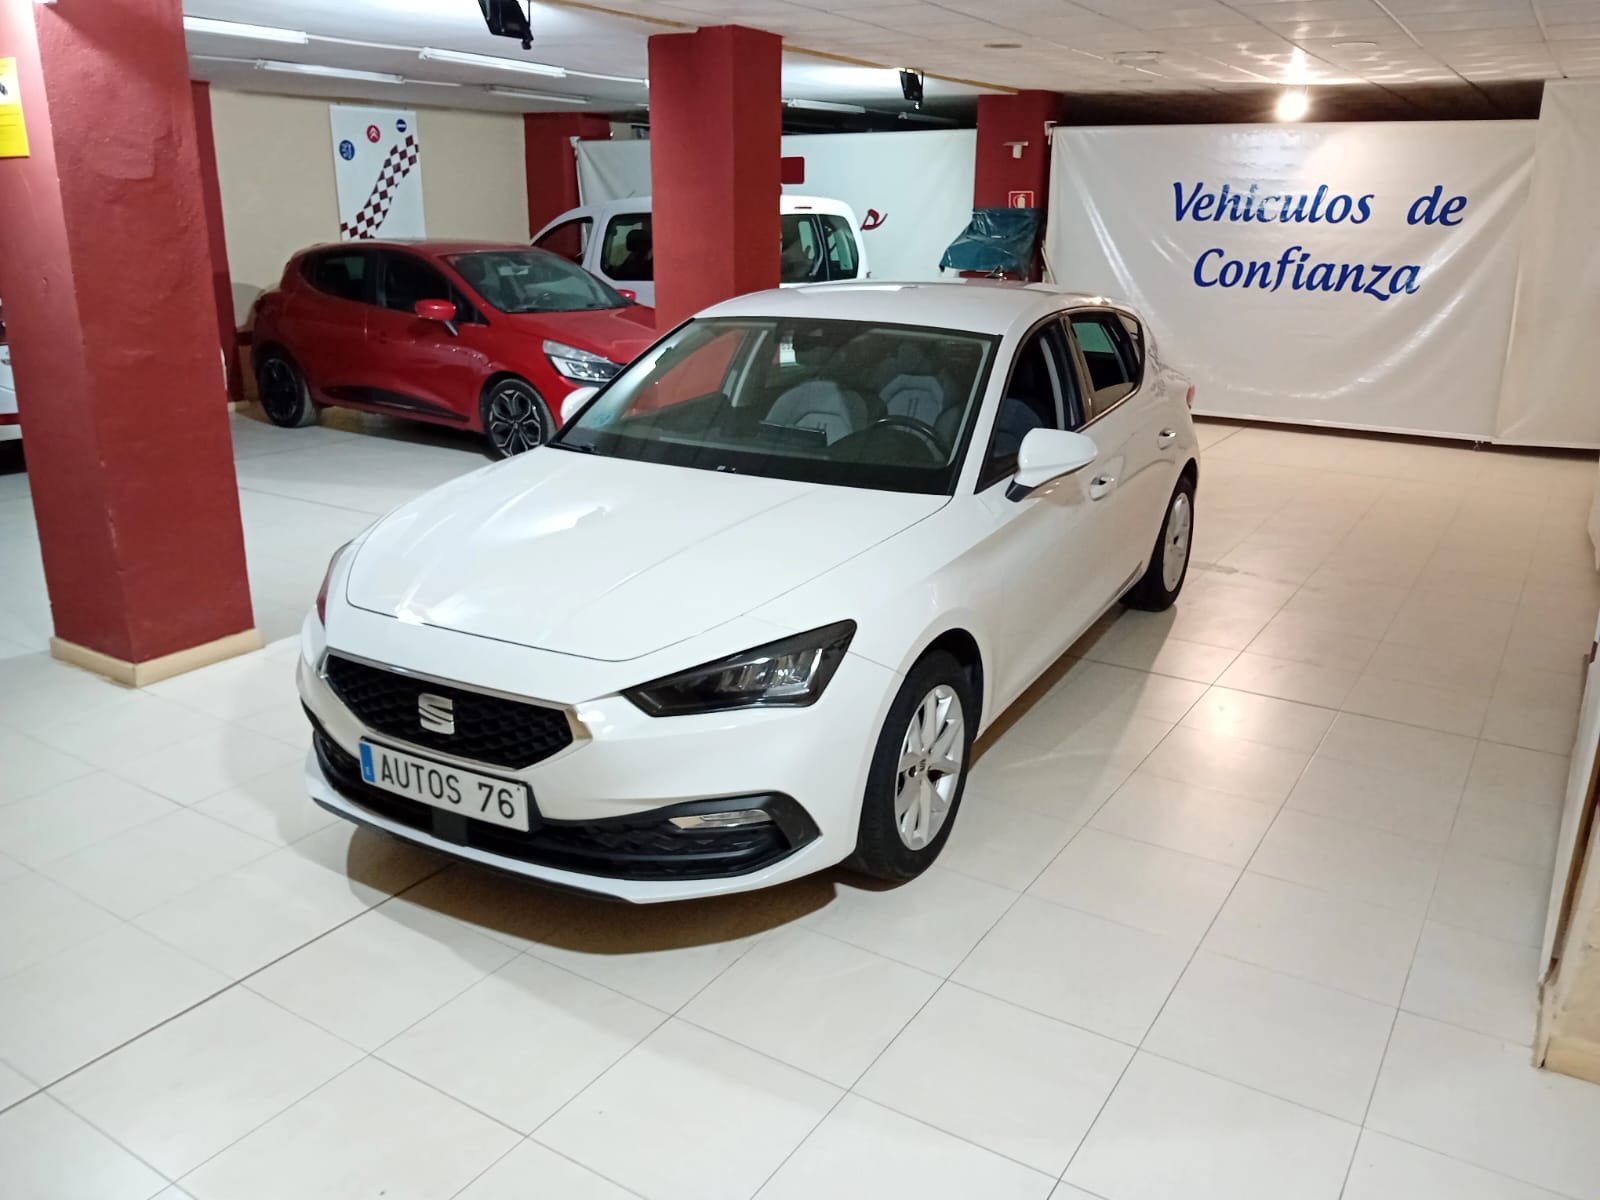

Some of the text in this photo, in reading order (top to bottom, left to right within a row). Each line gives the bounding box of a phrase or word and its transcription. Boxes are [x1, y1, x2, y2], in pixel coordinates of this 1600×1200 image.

[1406, 185, 1467, 226] de
[381, 754, 515, 819] AUTOS 76
